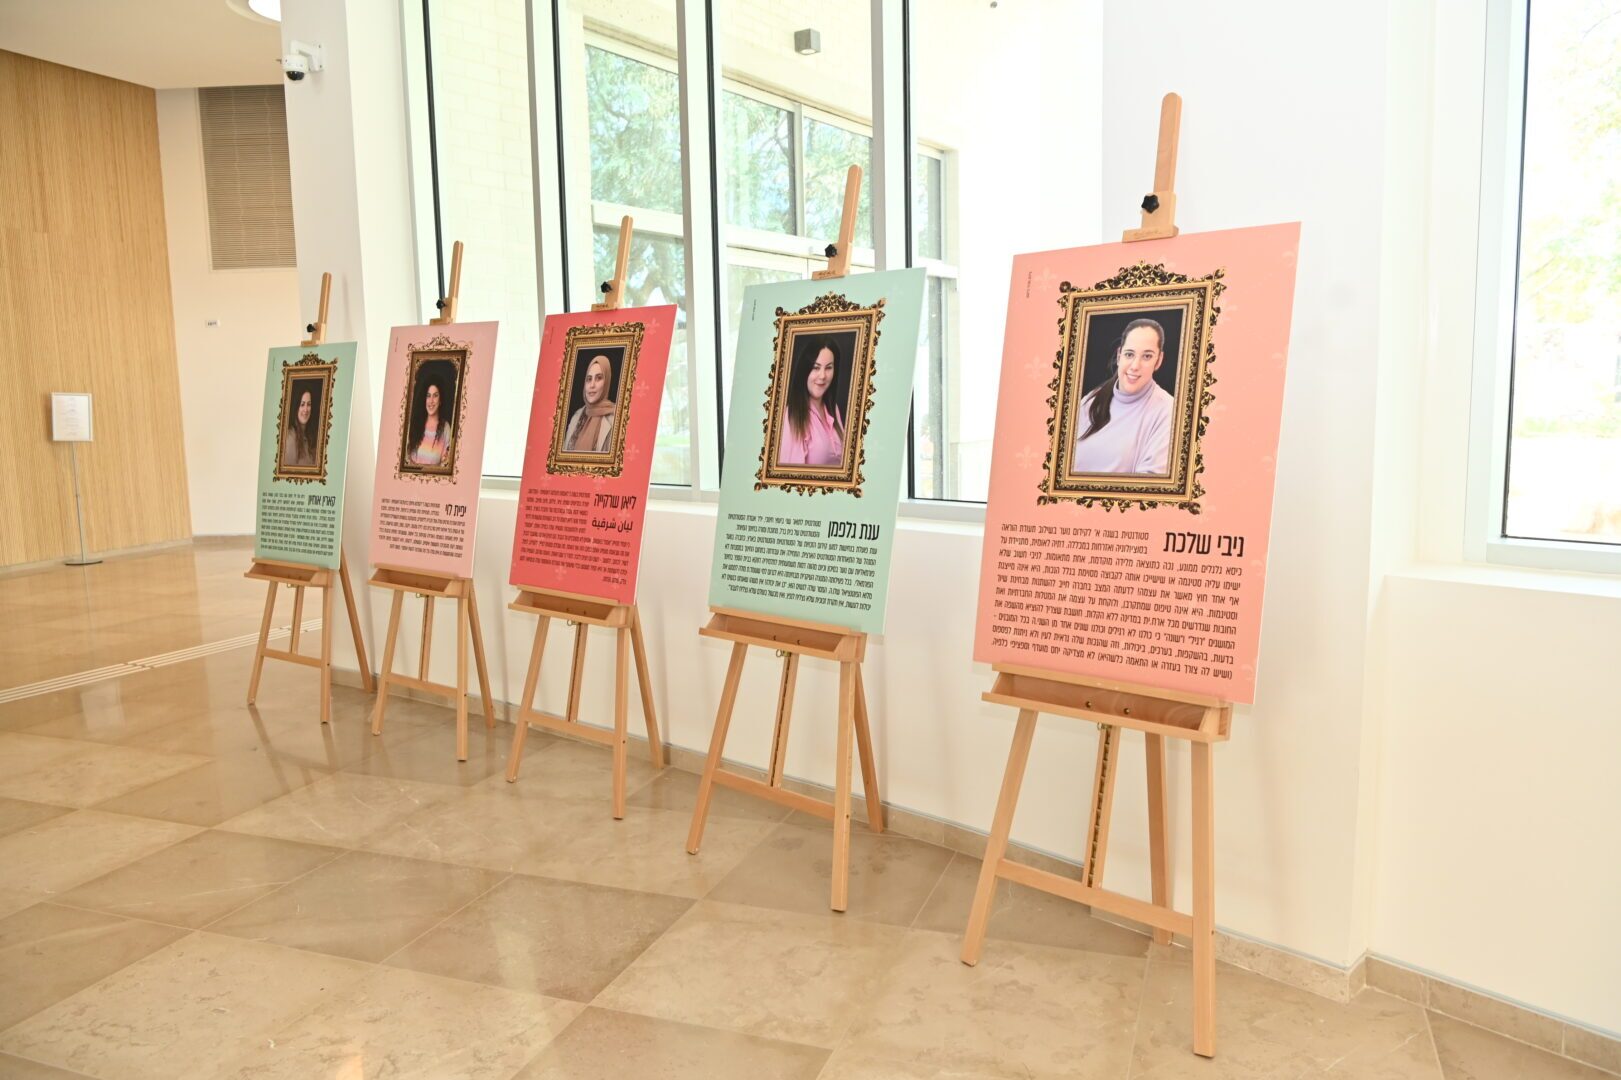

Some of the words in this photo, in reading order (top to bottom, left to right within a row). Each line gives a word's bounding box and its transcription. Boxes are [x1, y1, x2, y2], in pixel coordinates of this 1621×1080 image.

[827, 520, 856, 539] גלפמן
[858, 523, 880, 540] ענת
[1162, 531, 1211, 555] שלכת
[1216, 534, 1244, 557] ניבי
